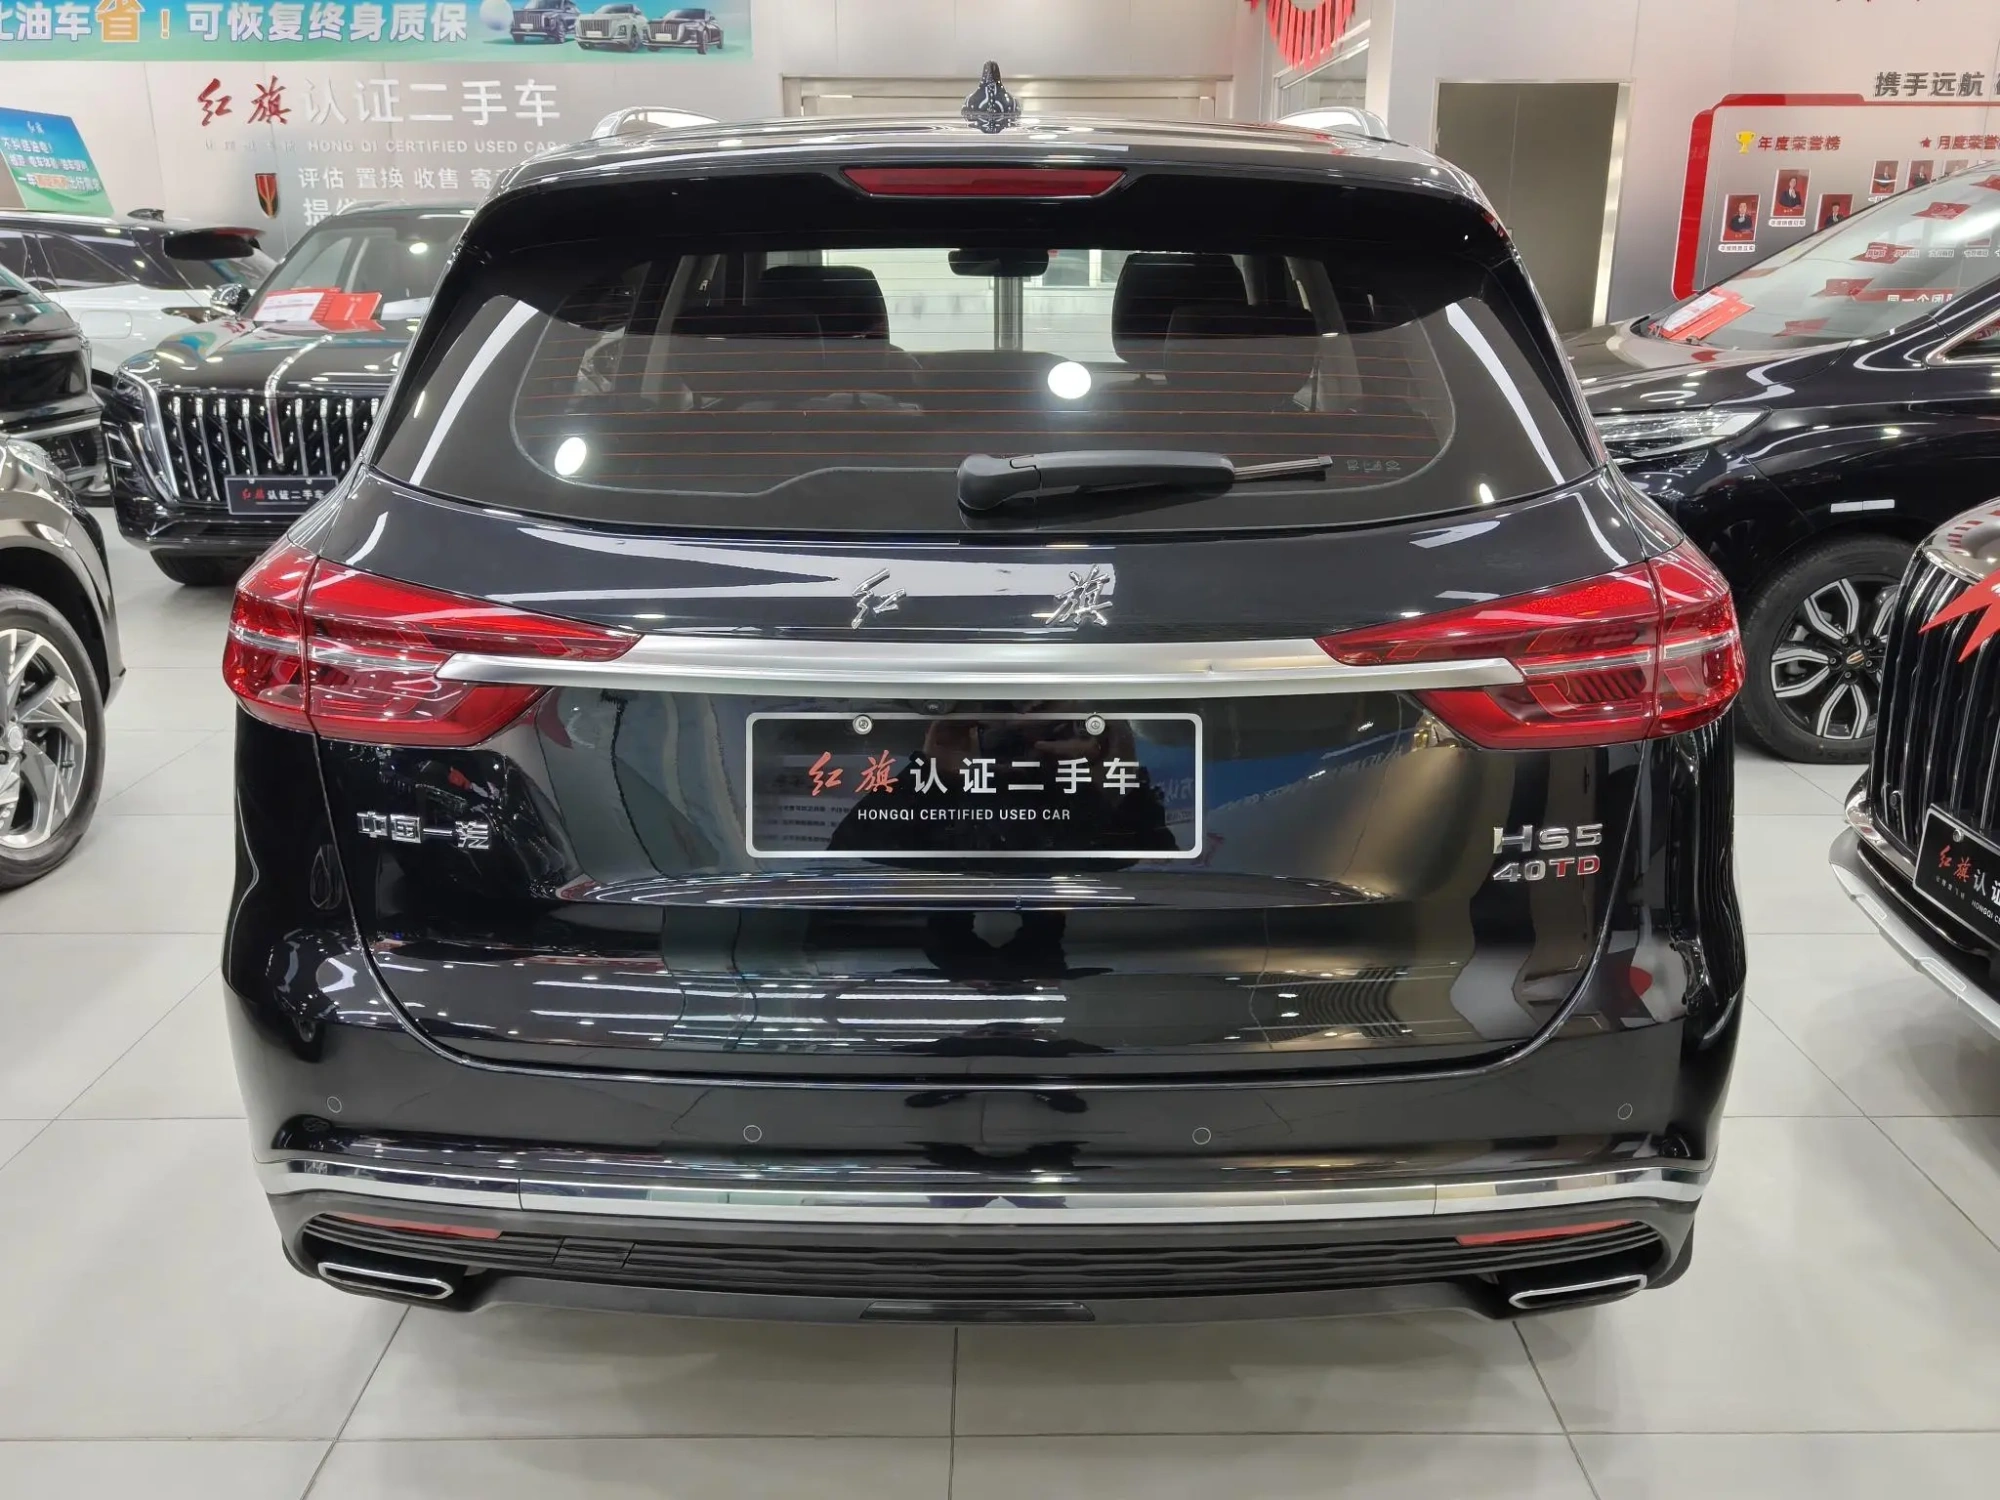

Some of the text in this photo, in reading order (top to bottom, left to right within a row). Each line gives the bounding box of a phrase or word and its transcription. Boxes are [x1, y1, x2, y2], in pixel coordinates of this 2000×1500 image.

[1873, 71, 1985, 97] 携手远航
[308, 140, 353, 153] HONG
[361, 141, 378, 153] QI
[385, 140, 468, 153] CERTIFIED
[474, 140, 518, 153] USED
[1758, 135, 1841, 151] 年度荣誉榜
[1937, 134, 2000, 150] 月度荣誉
[298, 167, 507, 191] 评估 置换 收售 寄
[808, 749, 1141, 797] 红旗认证二手车
[857, 808, 1071, 822] HONGQI CERTIFIED USED CAR
[357, 811, 490, 850] 中国一汽
[1493, 823, 1603, 854] HS5
[1493, 854, 1600, 882] 40TD
